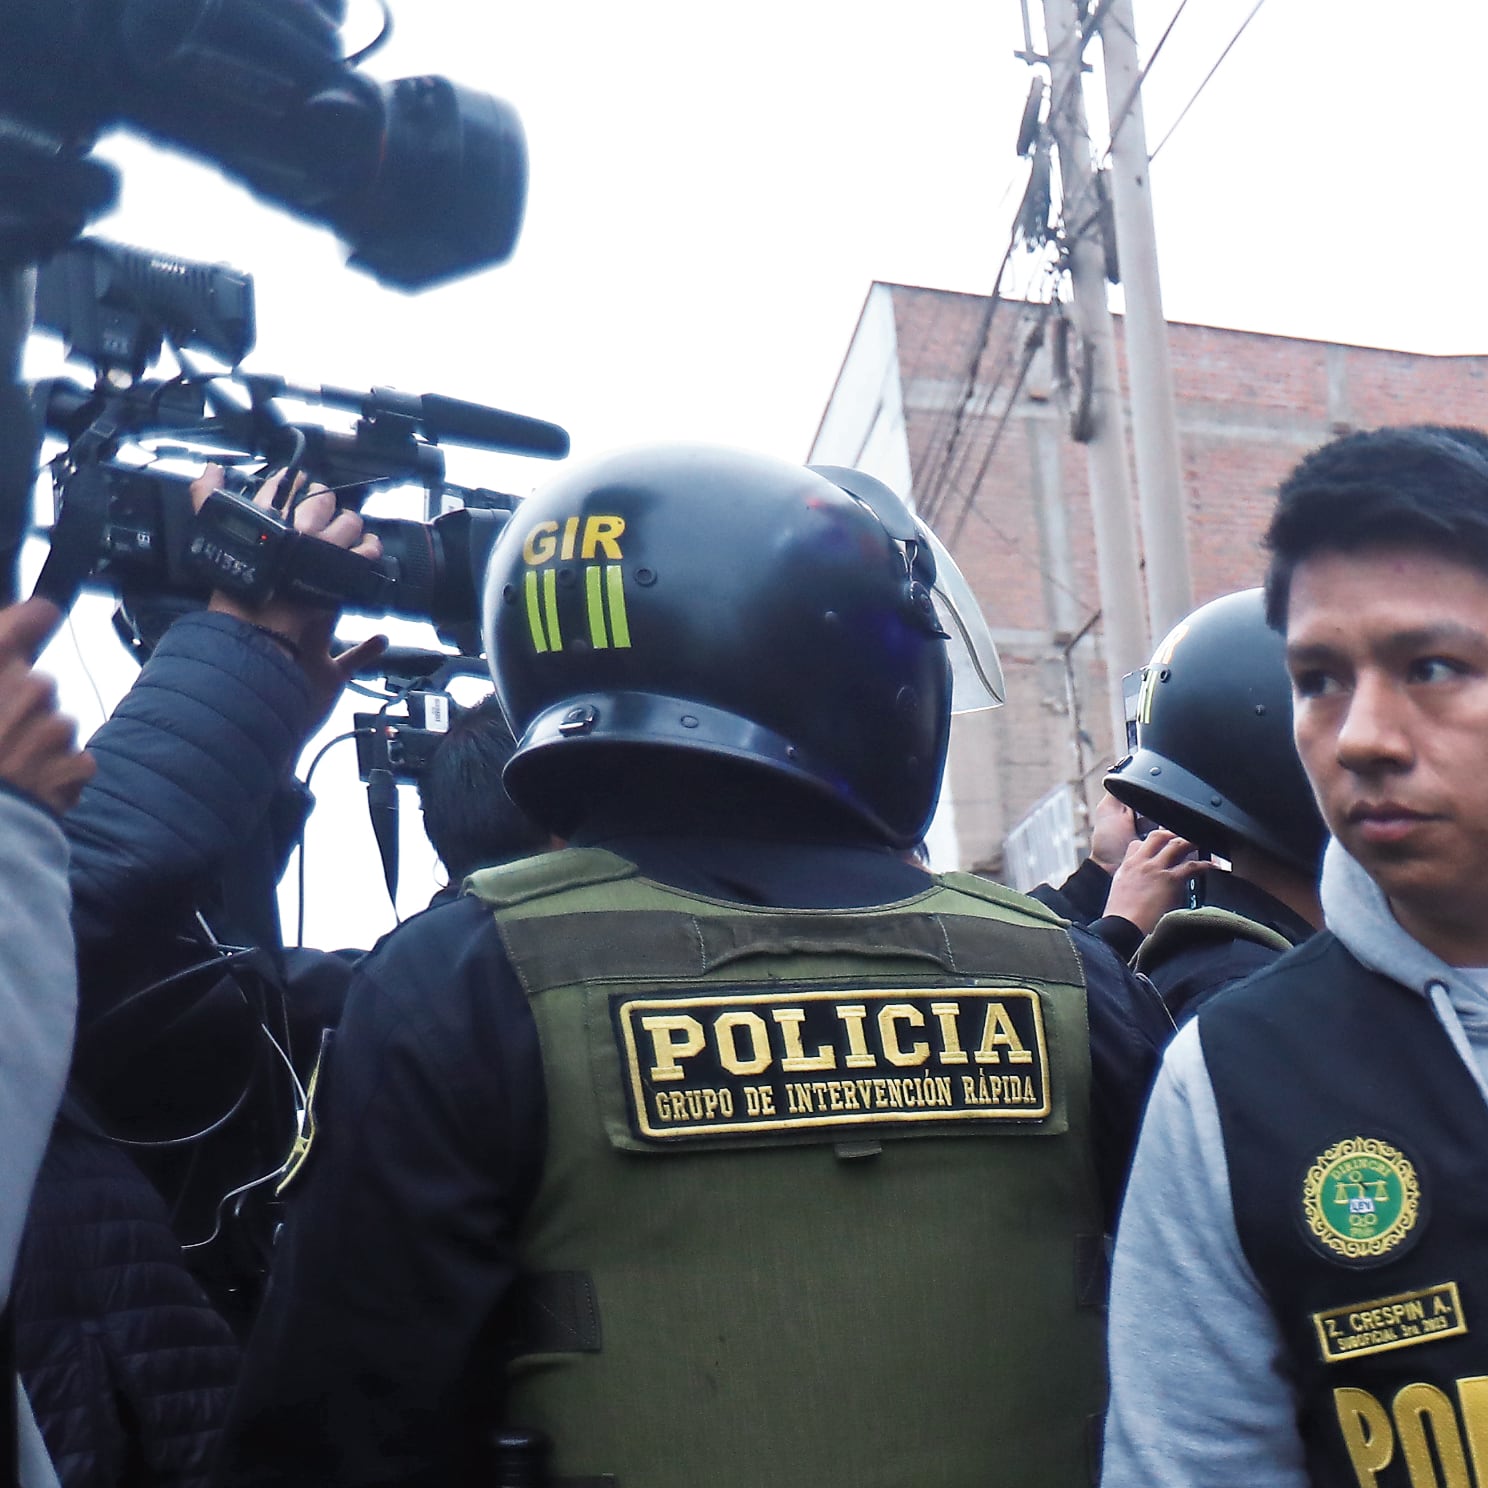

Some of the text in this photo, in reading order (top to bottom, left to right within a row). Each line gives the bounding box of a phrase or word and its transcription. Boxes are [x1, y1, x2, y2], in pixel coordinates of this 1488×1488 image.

[523, 515, 626, 565] GIR
[641, 1002, 1033, 1082] POLICIA
[655, 1088, 734, 1122] GRUPO
[746, 1085, 777, 1116] DE
[786, 1069, 952, 1114] INTERVENCIÓN
[1324, 1295, 1452, 1338] Z. CRESPIN A.
